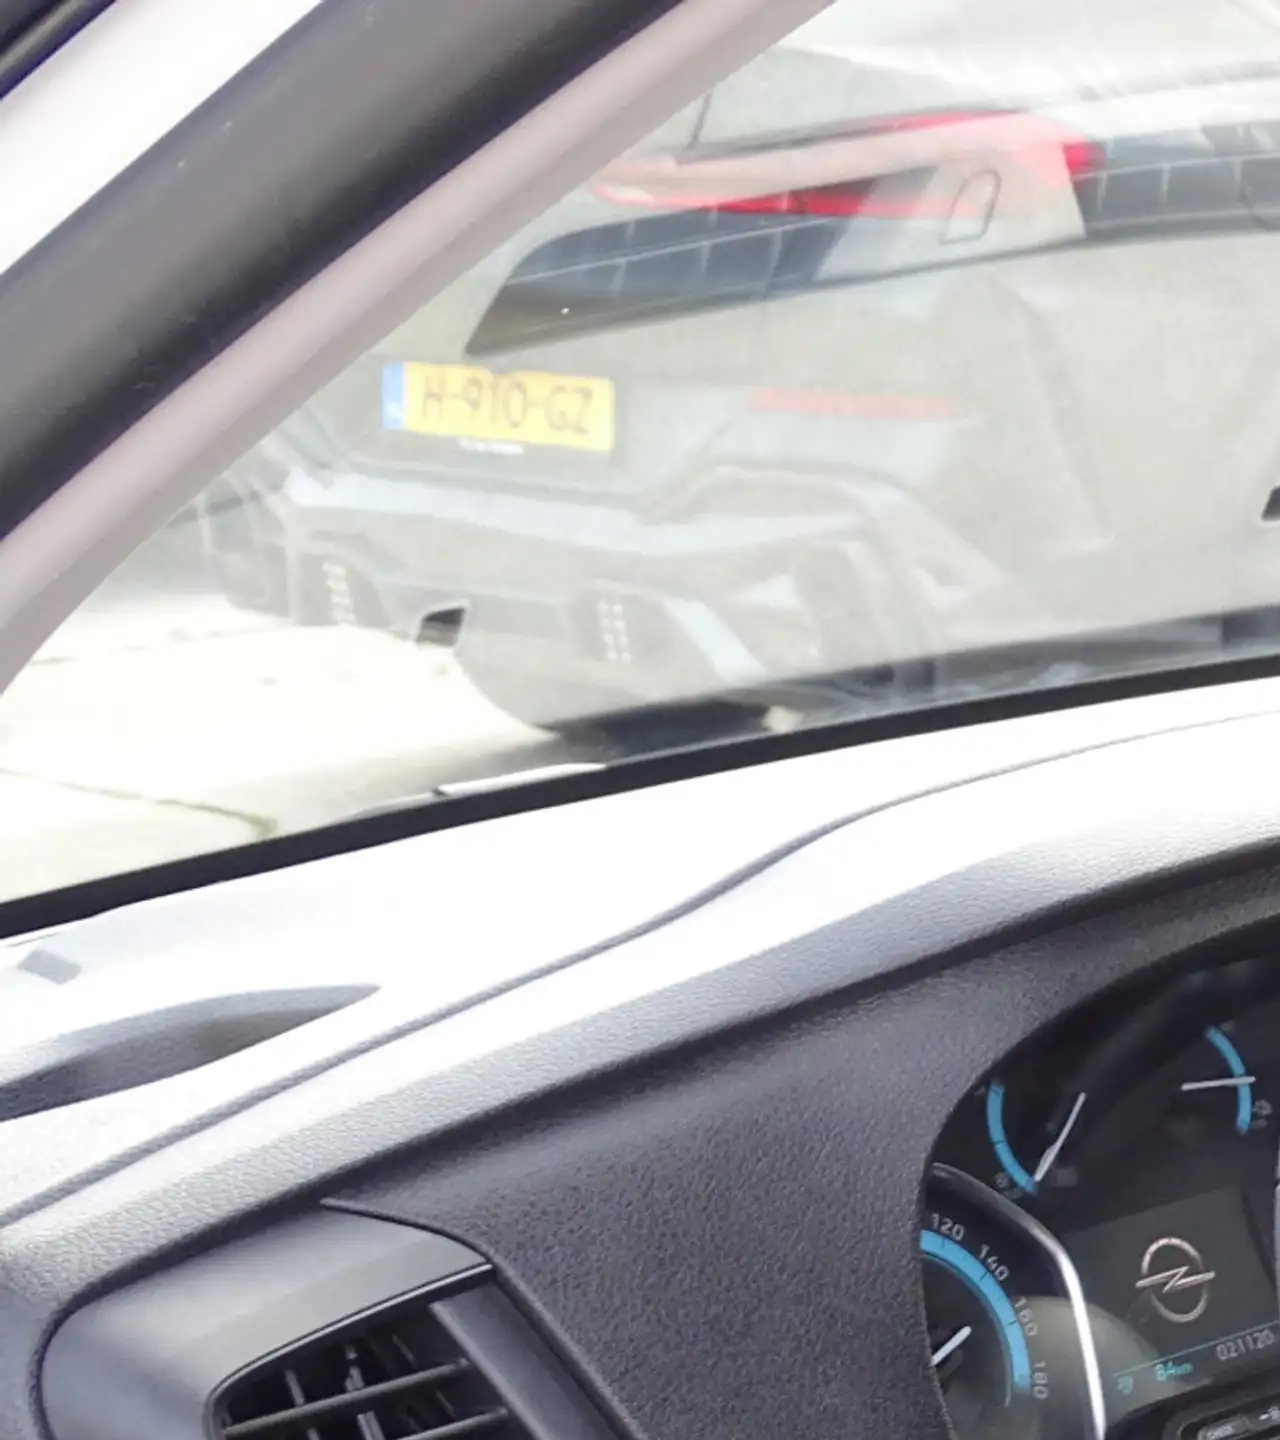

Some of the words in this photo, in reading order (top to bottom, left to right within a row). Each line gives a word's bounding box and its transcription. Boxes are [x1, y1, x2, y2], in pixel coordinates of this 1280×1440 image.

[930, 1213, 966, 1241] 120
[979, 1244, 1011, 1281] 140
[1014, 1297, 1039, 1337] 160
[1034, 1361, 1049, 1399] 180
